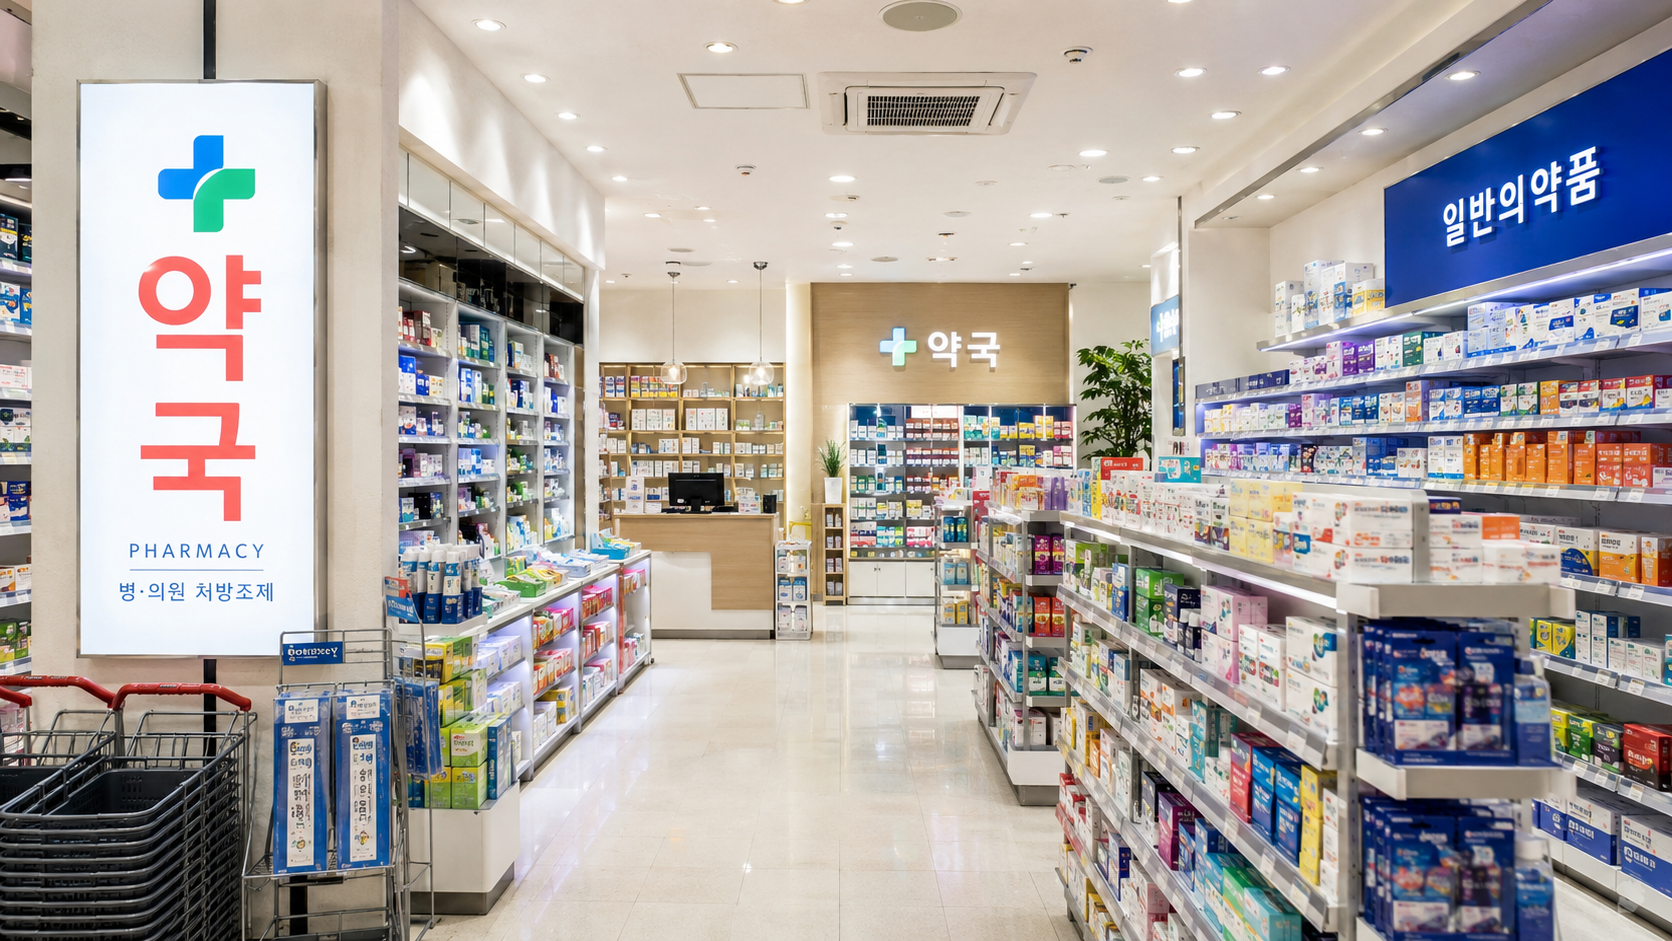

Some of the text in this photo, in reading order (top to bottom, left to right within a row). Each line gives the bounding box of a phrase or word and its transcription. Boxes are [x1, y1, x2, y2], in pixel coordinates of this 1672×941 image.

[1443, 146, 1601, 248] 일반의약품
[927, 331, 1001, 368] 약국
[138, 254, 262, 522] 약국
[129, 543, 264, 559] PHARMACY
[119, 581, 274, 603] 병·의원 처방조제
